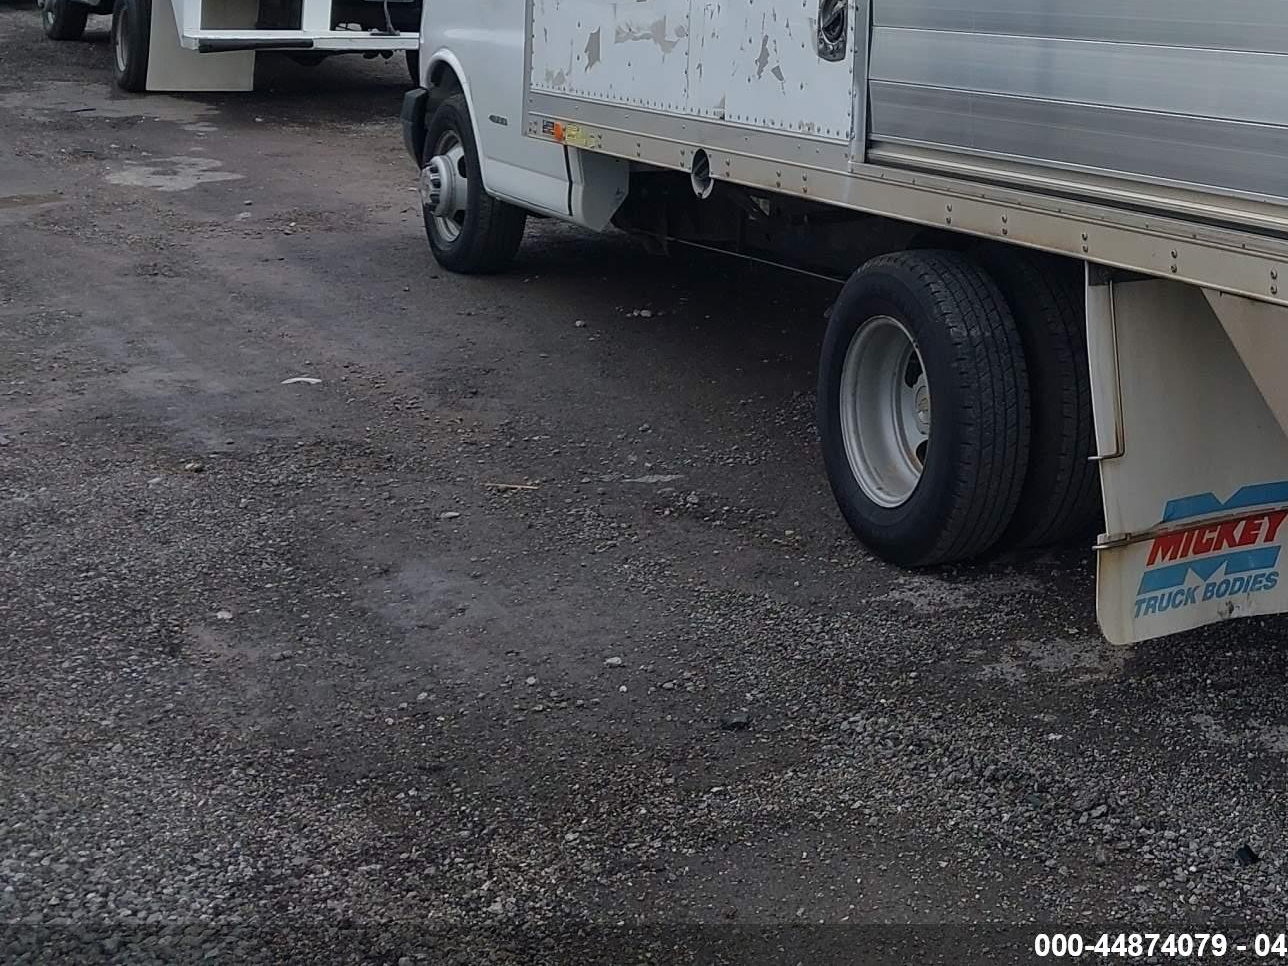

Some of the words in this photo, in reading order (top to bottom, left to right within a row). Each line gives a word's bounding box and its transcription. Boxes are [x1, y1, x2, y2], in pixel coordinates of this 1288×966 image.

[1146, 511, 1288, 567] MICKEY
[1134, 585, 1200, 619] TRUCK
[1202, 570, 1280, 602] BODIES
